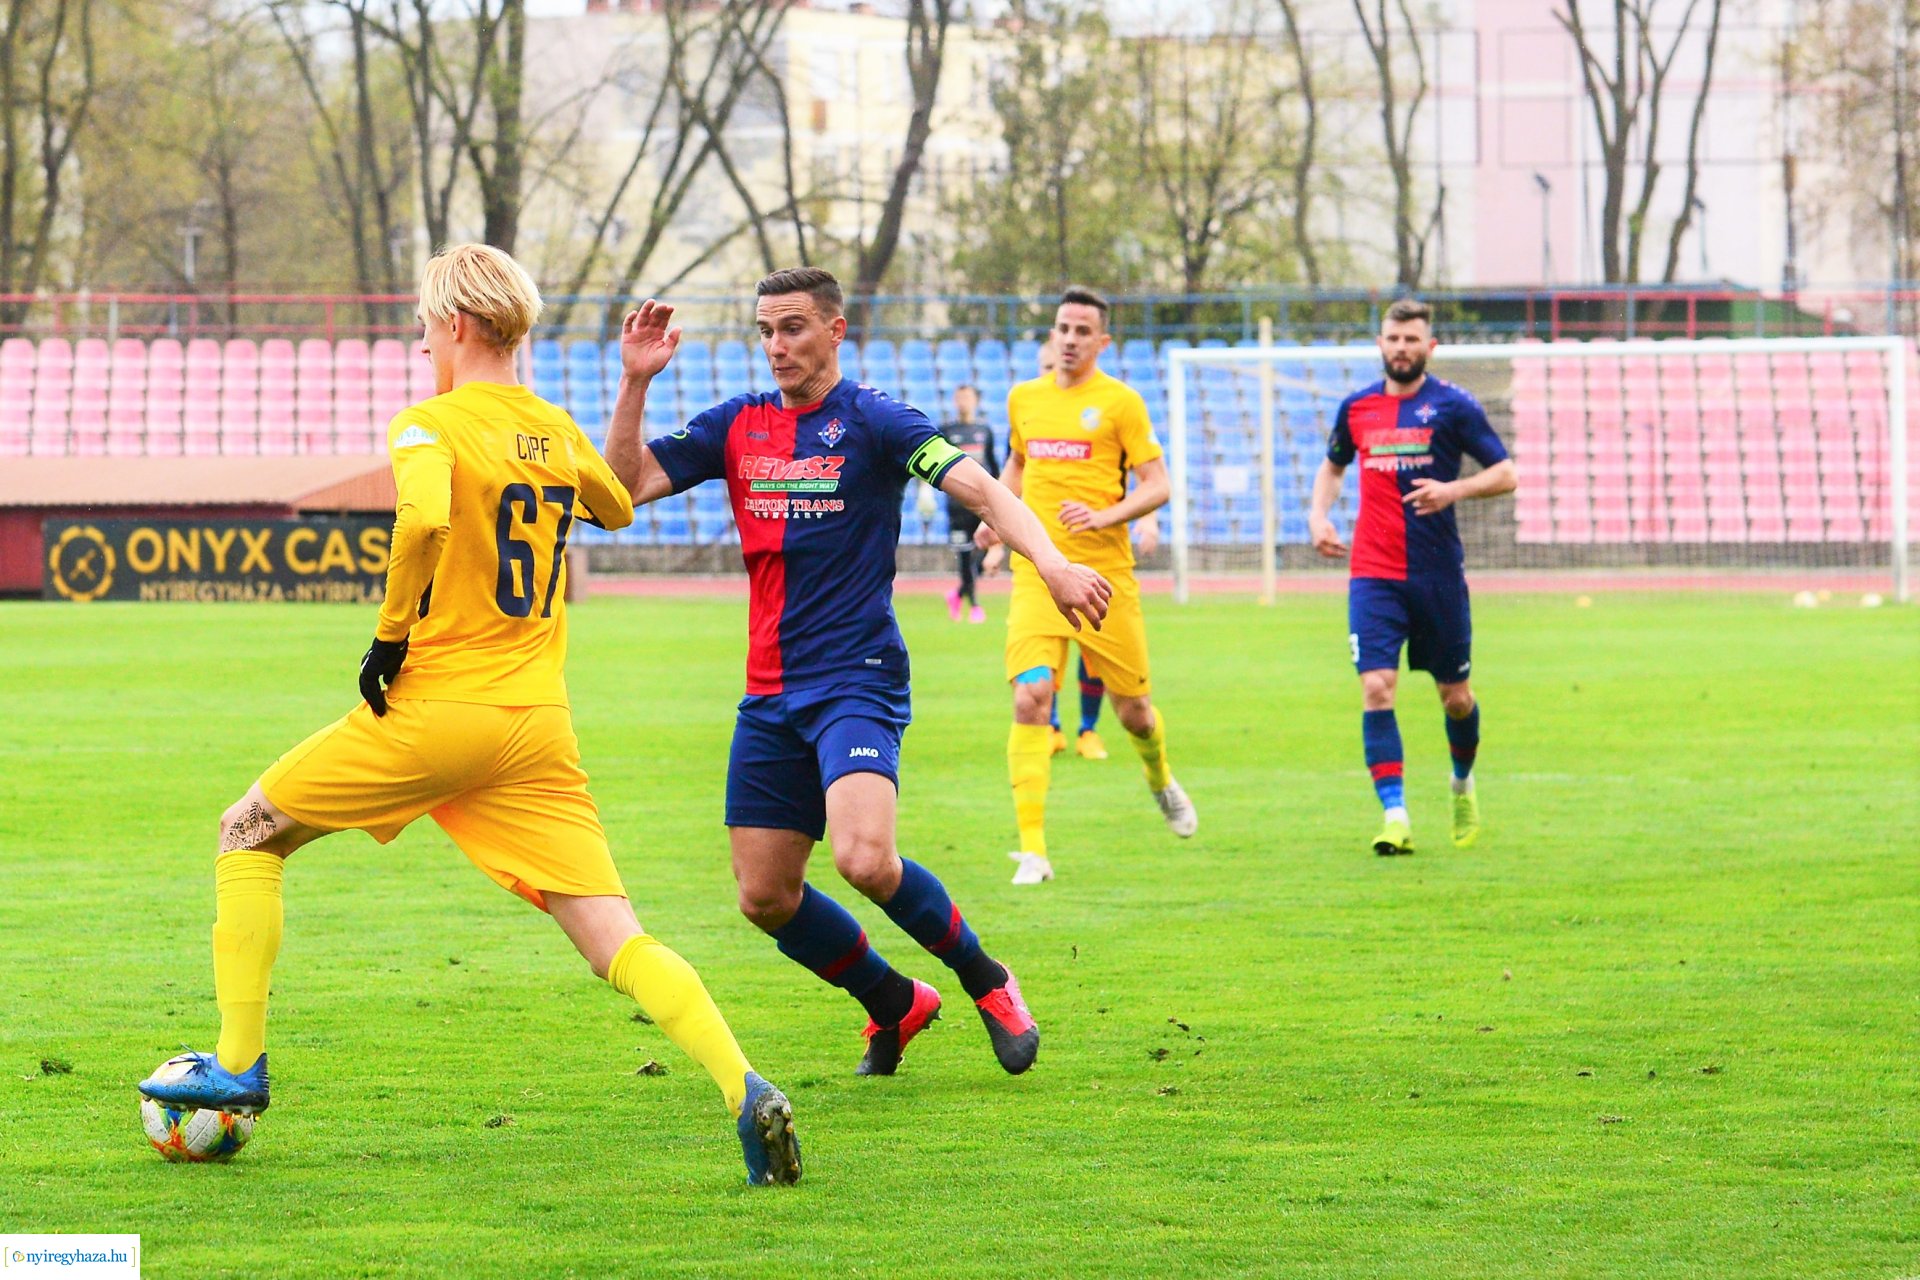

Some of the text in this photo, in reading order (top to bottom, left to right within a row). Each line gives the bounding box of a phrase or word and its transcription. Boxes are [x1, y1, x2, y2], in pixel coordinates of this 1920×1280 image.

[516, 433, 550, 463] CIPF
[818, 482, 836, 490] WAY
[791, 498, 845, 512] TRANS
[125, 526, 273, 574] ONYX
[496, 482, 575, 618] 67
[849, 747, 879, 758] JAKO
